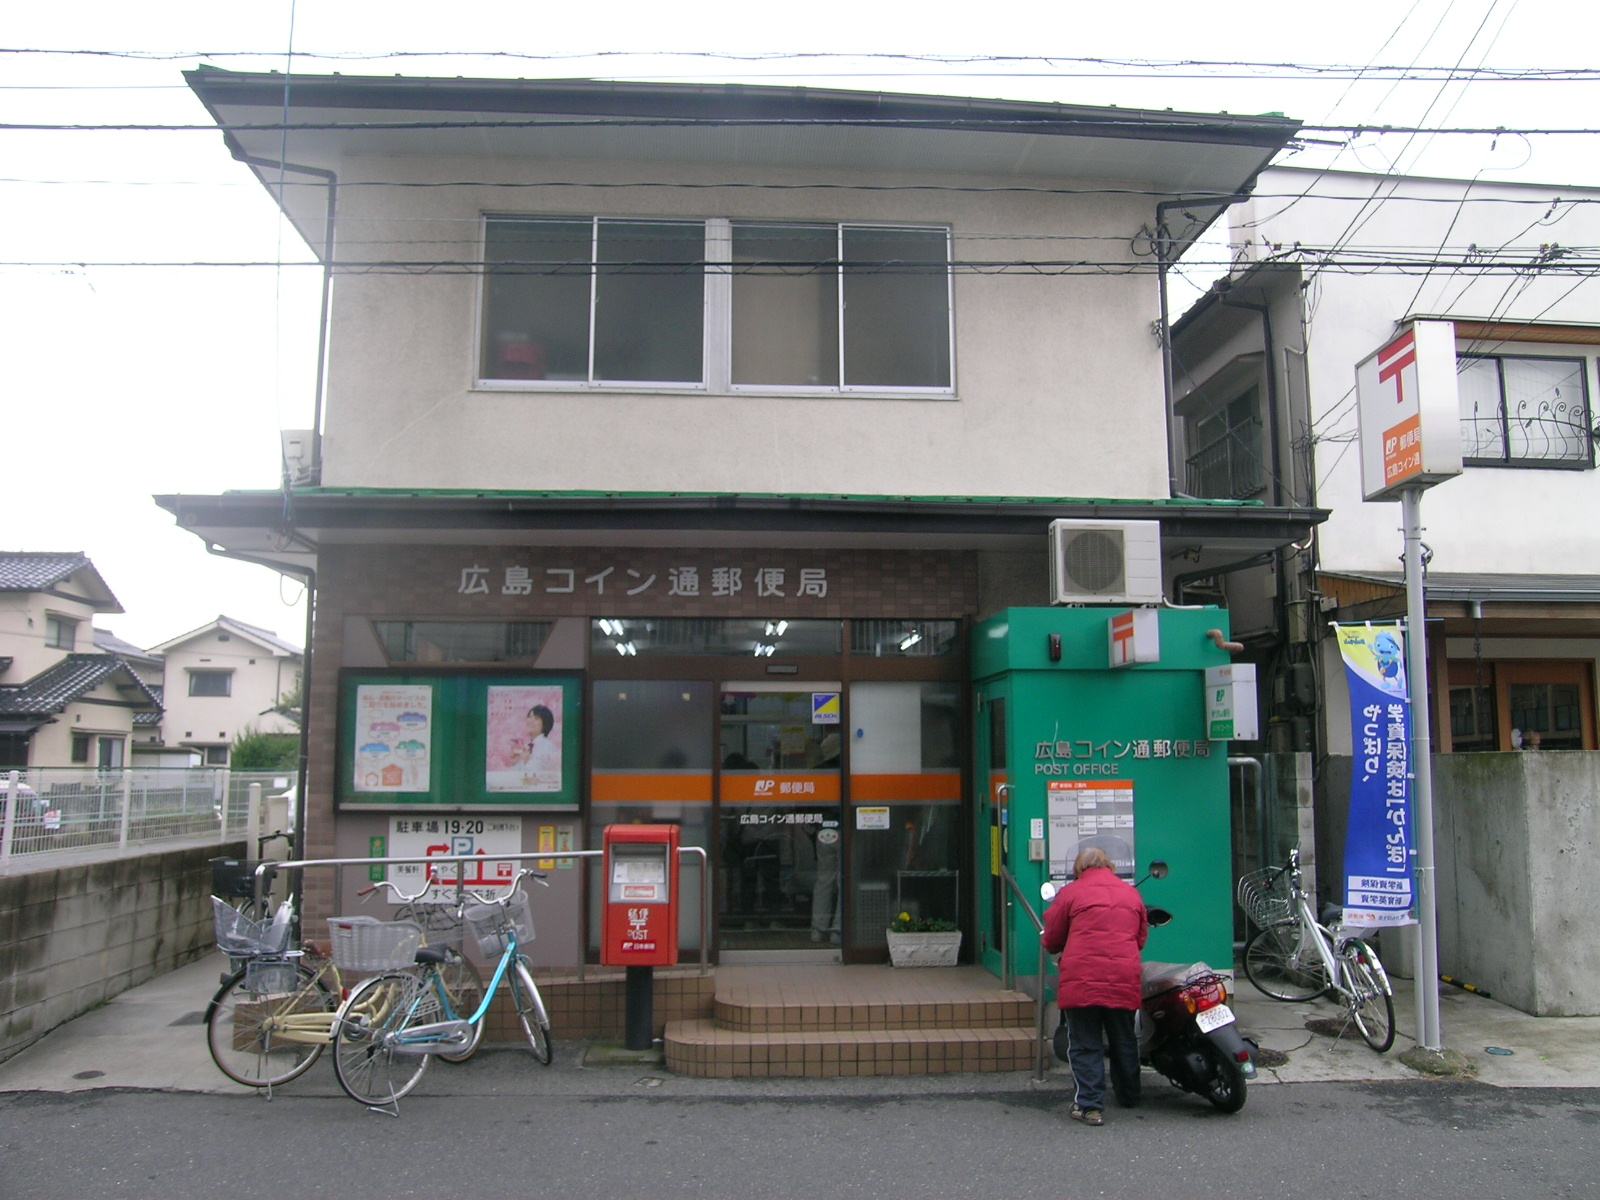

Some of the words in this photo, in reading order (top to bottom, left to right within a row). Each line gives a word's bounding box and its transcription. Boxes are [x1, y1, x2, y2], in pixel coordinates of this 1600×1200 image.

[1400, 427, 1420, 450] 郵便局
[1387, 452, 1420, 478] 広島コイン通
[458, 564, 828, 598] 広島コイン通郵便局
[1034, 739, 1211, 760] 広島コイン通郵便局
[1035, 764, 1070, 775] POST
[1073, 763, 1119, 775] OFFICE
[780, 782, 814, 794] 郵便局
[740, 813, 823, 825] 広島コイン通郵便局
[396, 820, 440, 834] 駐車場
[628, 908, 649, 920] 郵便
[627, 929, 649, 940] POST
